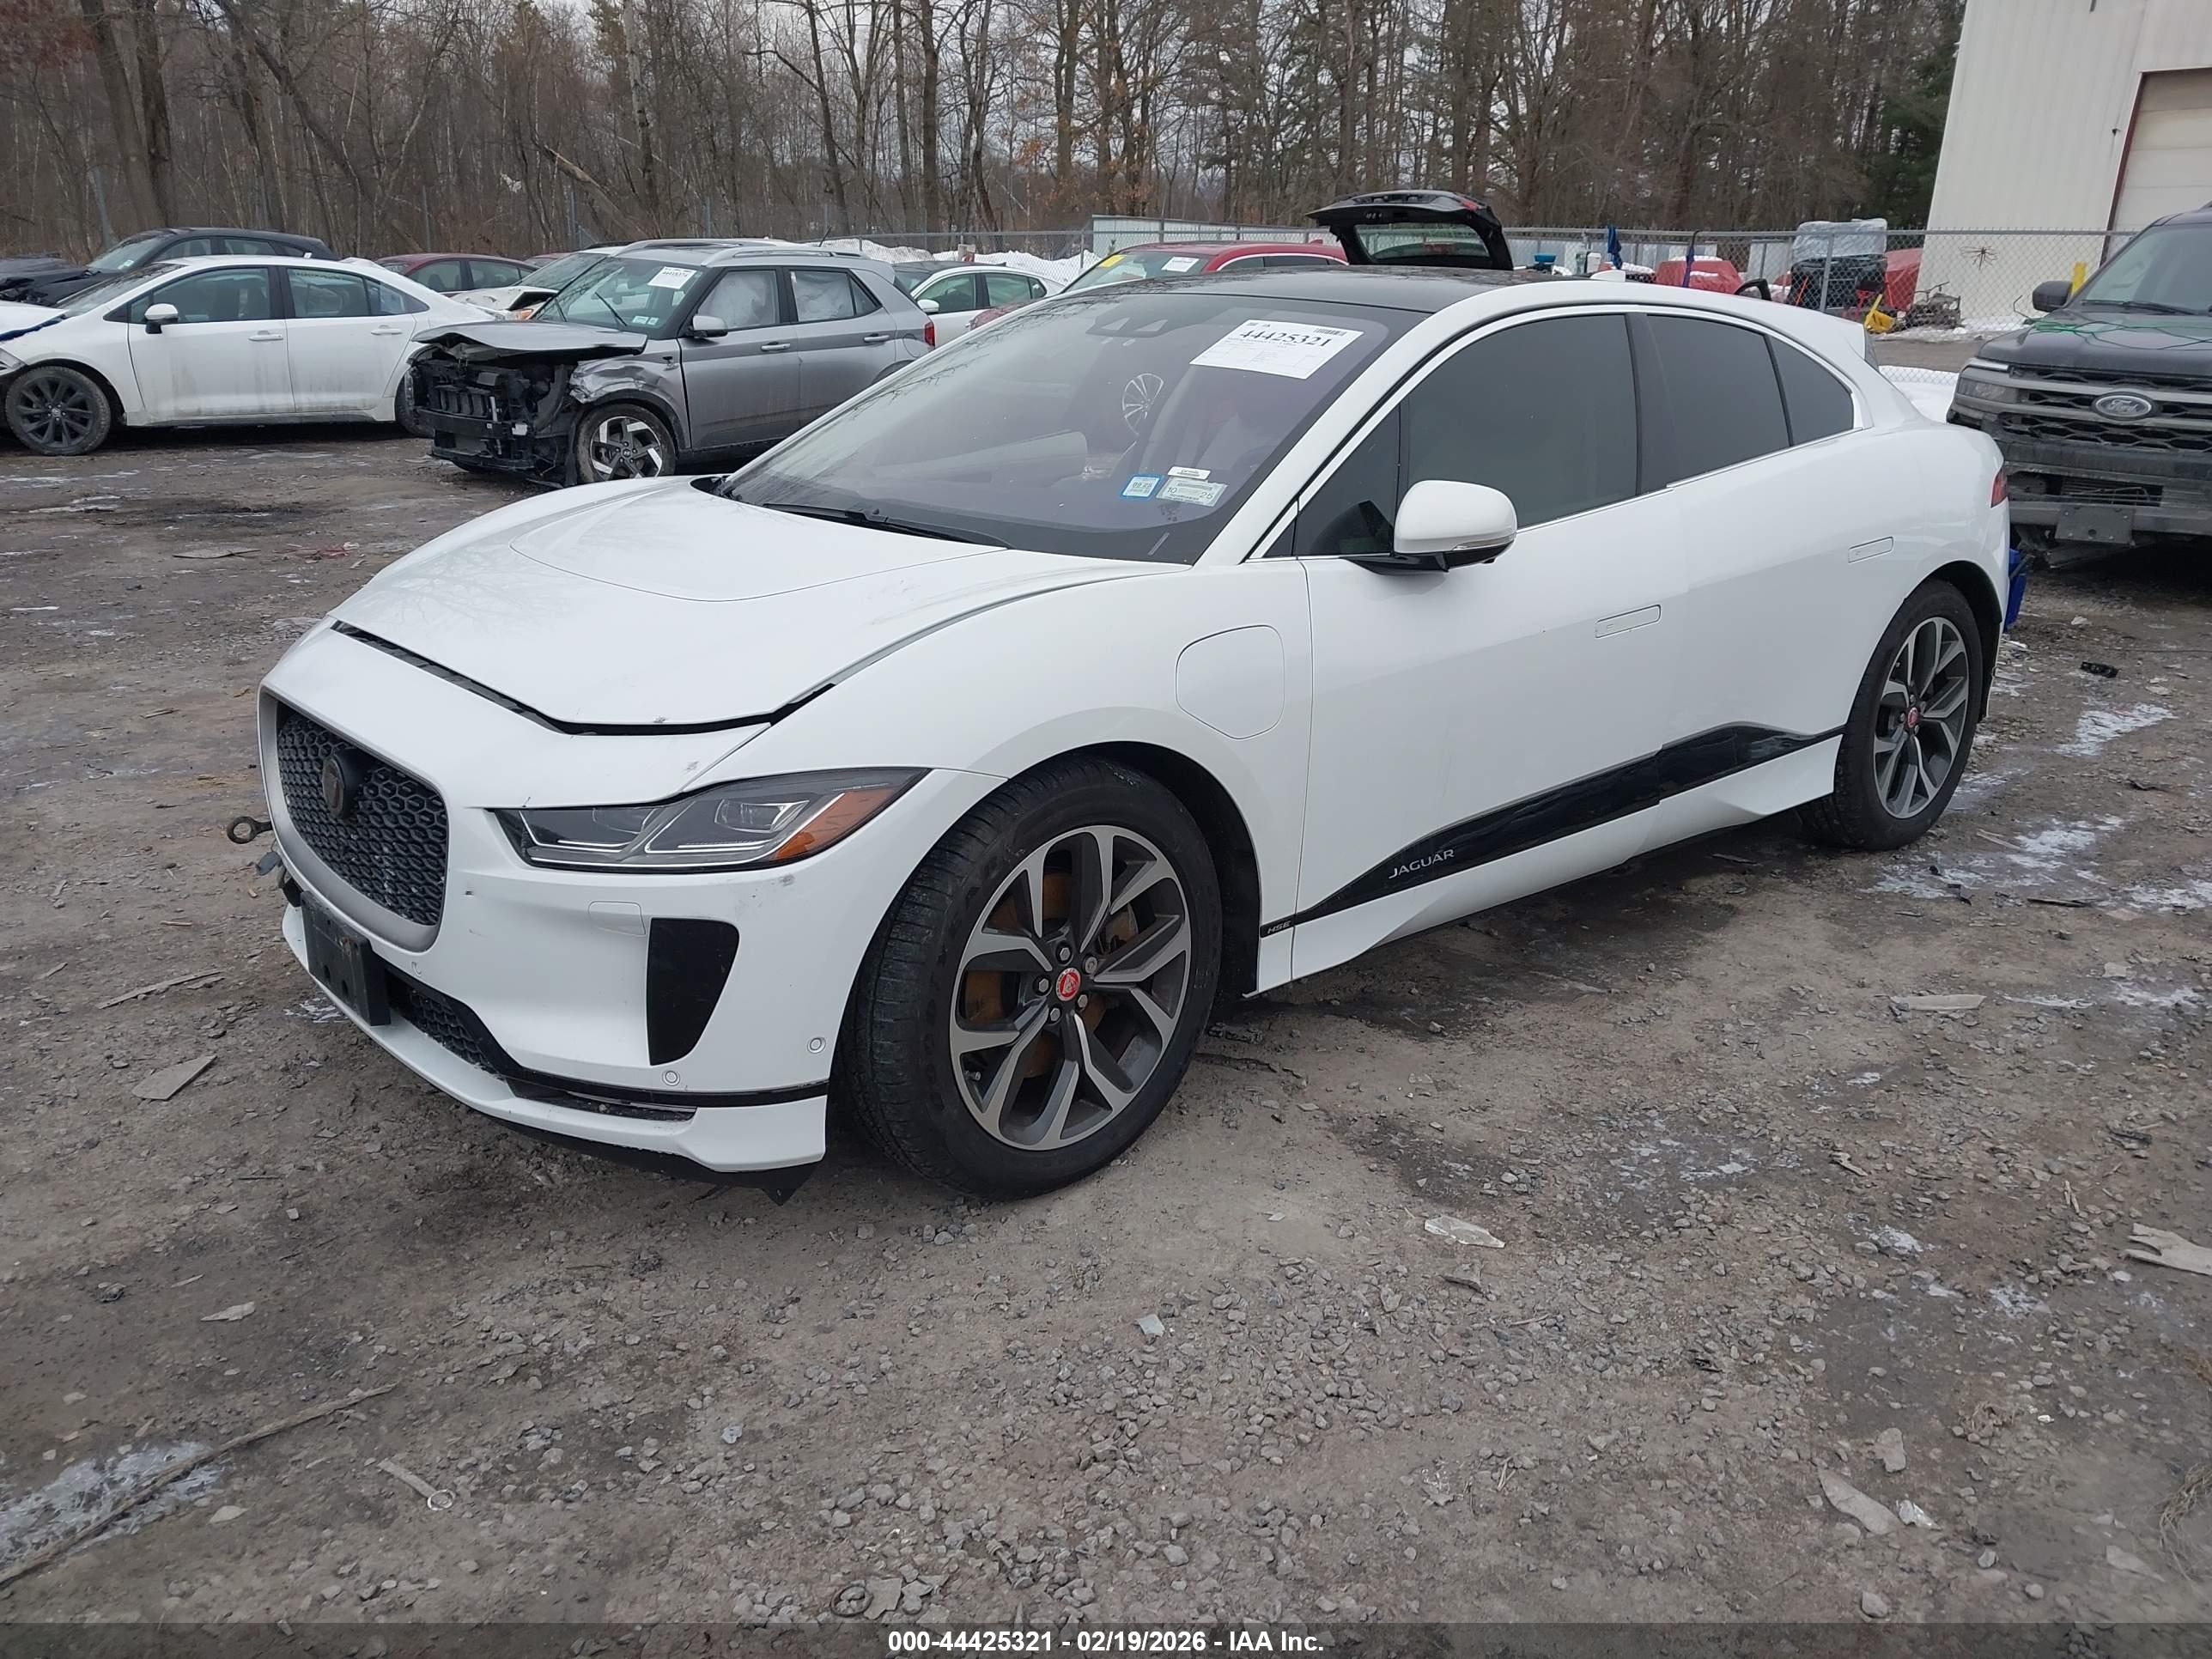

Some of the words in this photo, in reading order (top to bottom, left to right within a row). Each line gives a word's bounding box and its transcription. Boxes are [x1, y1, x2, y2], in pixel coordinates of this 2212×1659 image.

[1240, 330, 1332, 347] 44425321
[1388, 848, 1455, 880] JAGUAR
[1267, 920, 1292, 935] HSE
